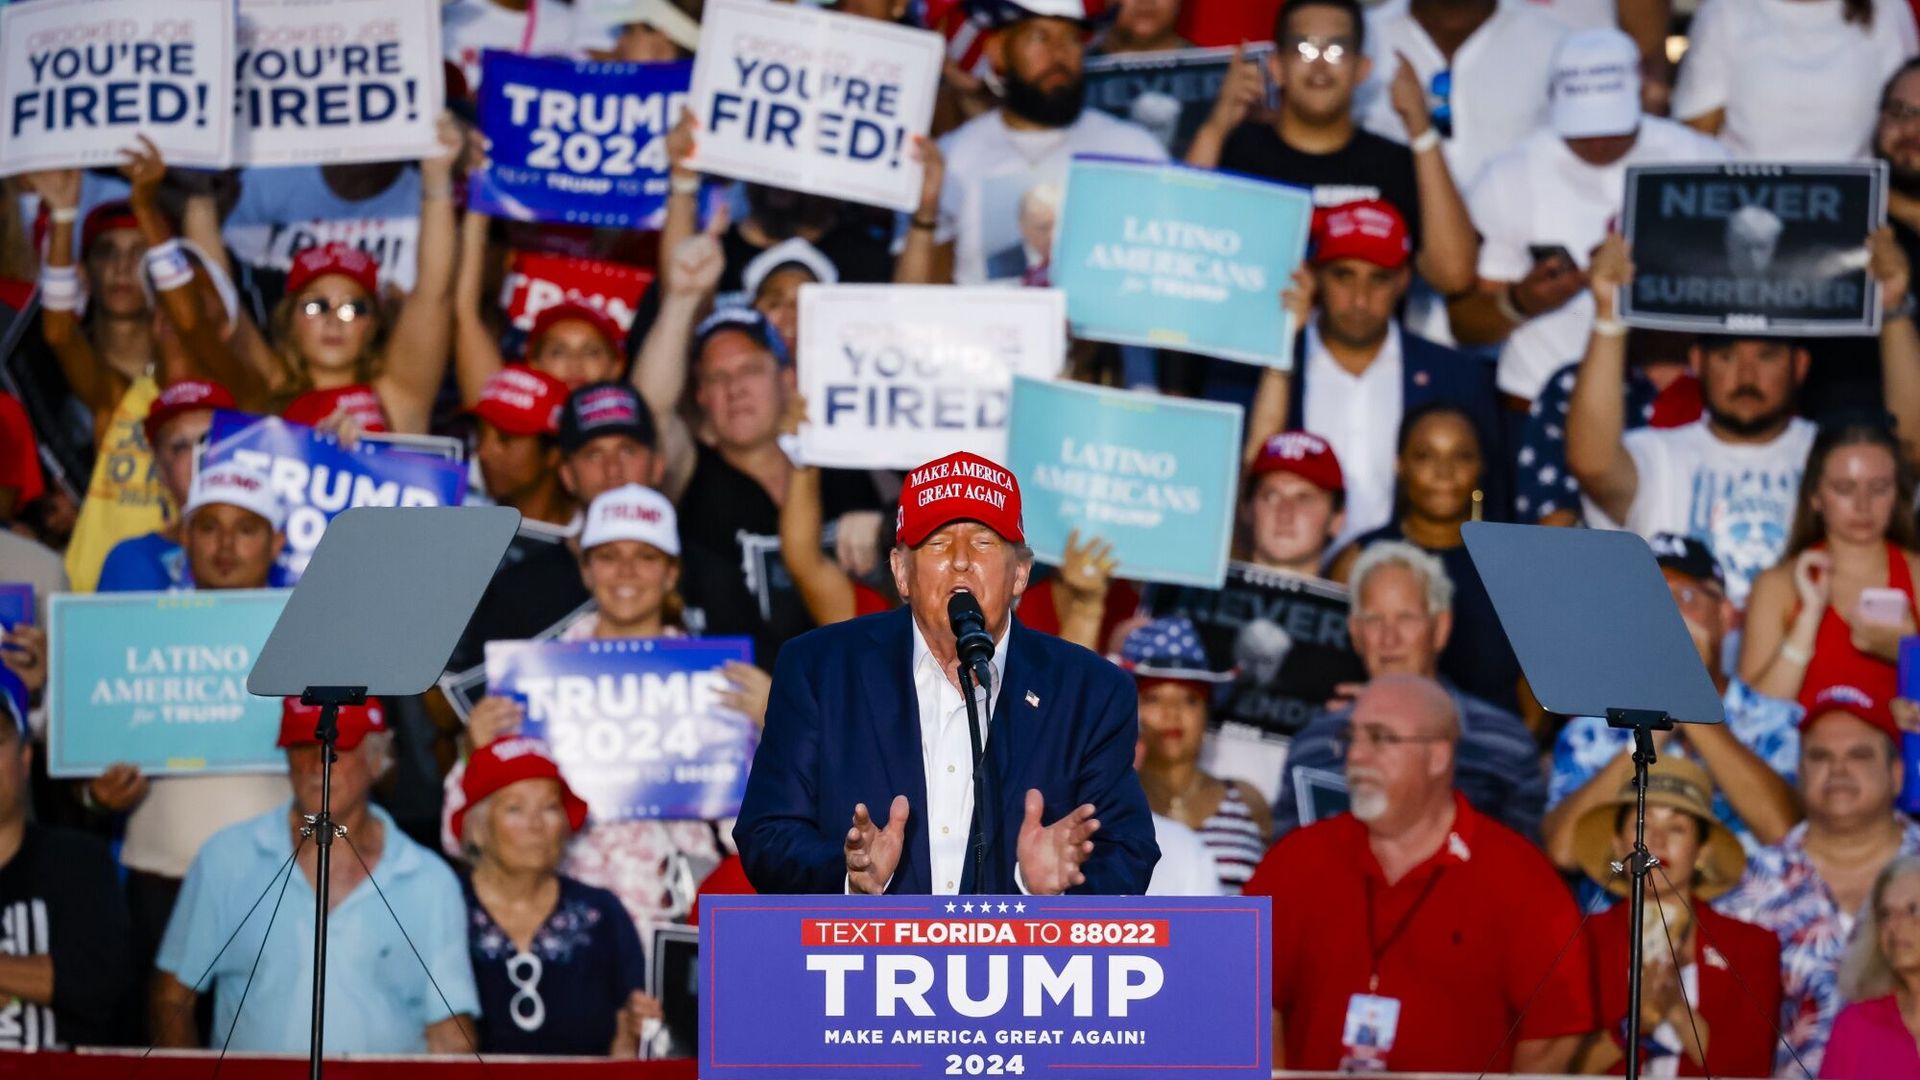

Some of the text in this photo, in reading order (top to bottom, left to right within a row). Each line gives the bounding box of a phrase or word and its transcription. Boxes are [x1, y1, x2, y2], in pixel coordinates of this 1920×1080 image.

[29, 43, 195, 84] YOU'RE
[235, 42, 402, 80] YOU'RE
[234, 79, 418, 128] IRED!
[734, 57, 899, 116] YOU'RE
[12, 82, 208, 137] FIRED!
[709, 92, 905, 168] FIRED!
[526, 127, 668, 174] 2024
[1660, 182, 1842, 221] NEVER
[1122, 215, 1242, 256] LATINO
[1085, 243, 1266, 292] AMERICANS
[1637, 274, 1858, 309] SURRENDER
[911, 461, 1014, 492] MAKE AMERICA
[1060, 436, 1177, 480] LATINO
[918, 483, 1006, 511] GREAT AGAIN
[1032, 463, 1200, 513] AMERICANS
[1190, 590, 1347, 648] EVER
[126, 645, 249, 673] LATINO
[91, 676, 249, 704] AMERICA
[514, 670, 730, 721] TRUMP
[160, 705, 244, 723] TRUMP
[552, 718, 700, 763] 2024
[816, 922, 1155, 944] TEXT FLORIDA TO 88022
[806, 954, 1164, 1018] TRUMP
[825, 1029, 1146, 1045] MAKE AMERICA GREAT AGAIN!
[945, 1054, 1025, 1075] 2024
